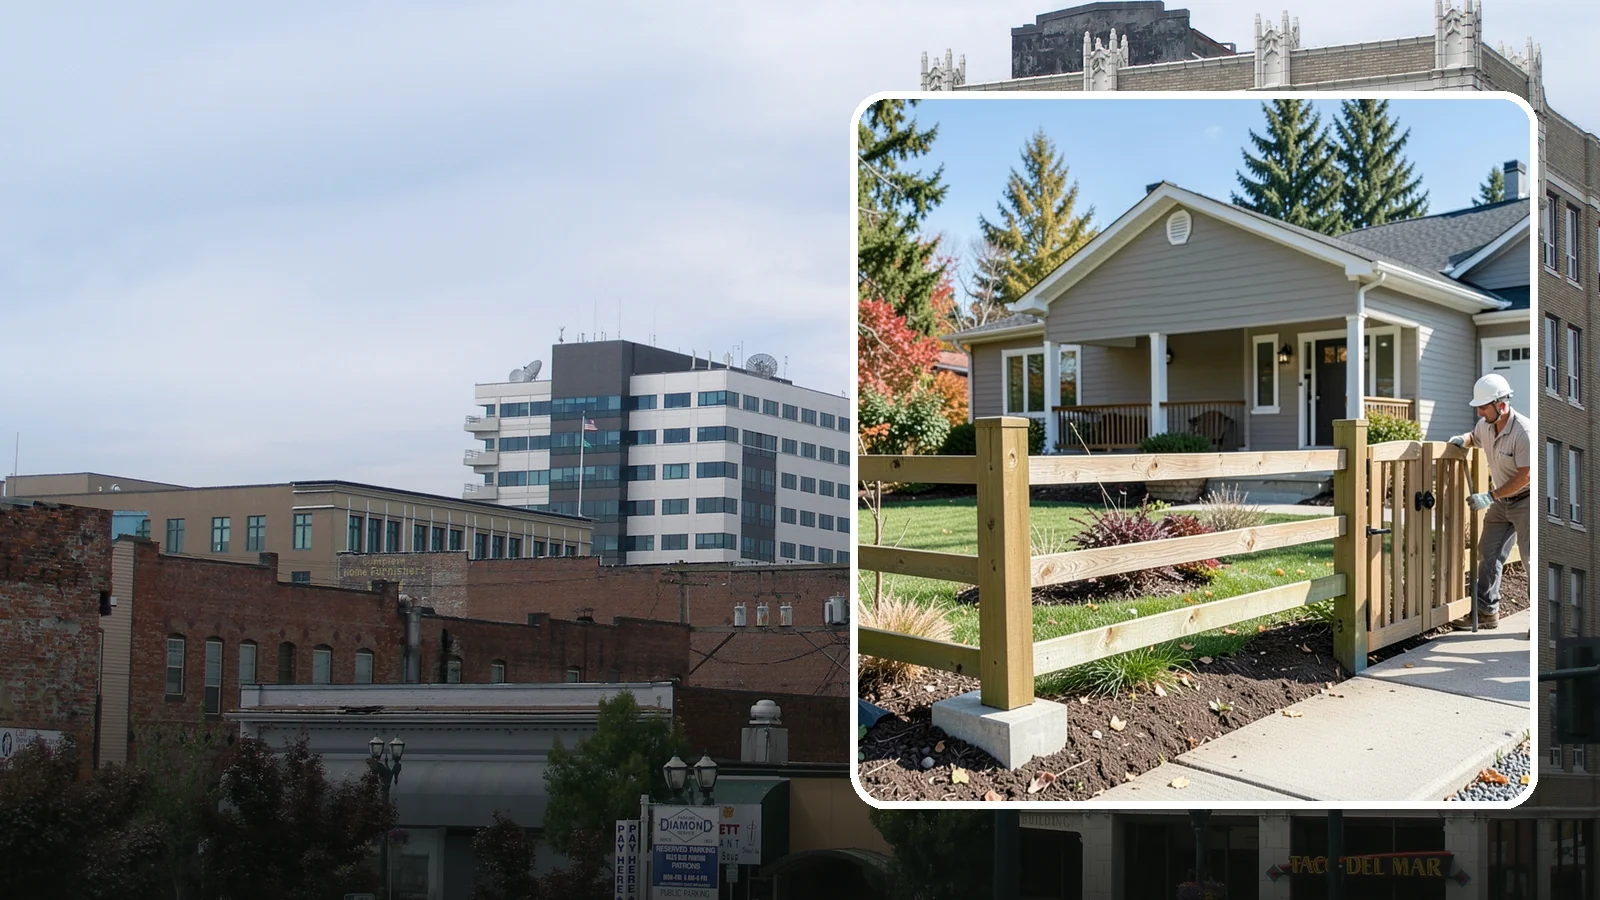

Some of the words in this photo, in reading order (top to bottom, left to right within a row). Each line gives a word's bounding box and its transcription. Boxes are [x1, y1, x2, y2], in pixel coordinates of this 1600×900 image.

[343, 568, 367, 577] Home
[370, 566, 427, 576] Furnishers
[660, 818, 713, 833] DIAMOND
[1022, 815, 1069, 828] BUILDING
[719, 824, 740, 835] ETT
[617, 825, 625, 852] PAY
[628, 824, 637, 852] PAY
[719, 838, 740, 849] ANT
[656, 845, 687, 853] RESERVED
[689, 846, 716, 854] PARKING
[722, 851, 739, 862] Soup
[1289, 855, 1329, 874] TAC
[1346, 856, 1385, 876] DEL
[1392, 856, 1443, 877] MAR
[616, 855, 625, 894] HERE
[627, 855, 636, 894] HERE
[660, 889, 682, 897] PUBLIC
[683, 889, 710, 898] PARKING
